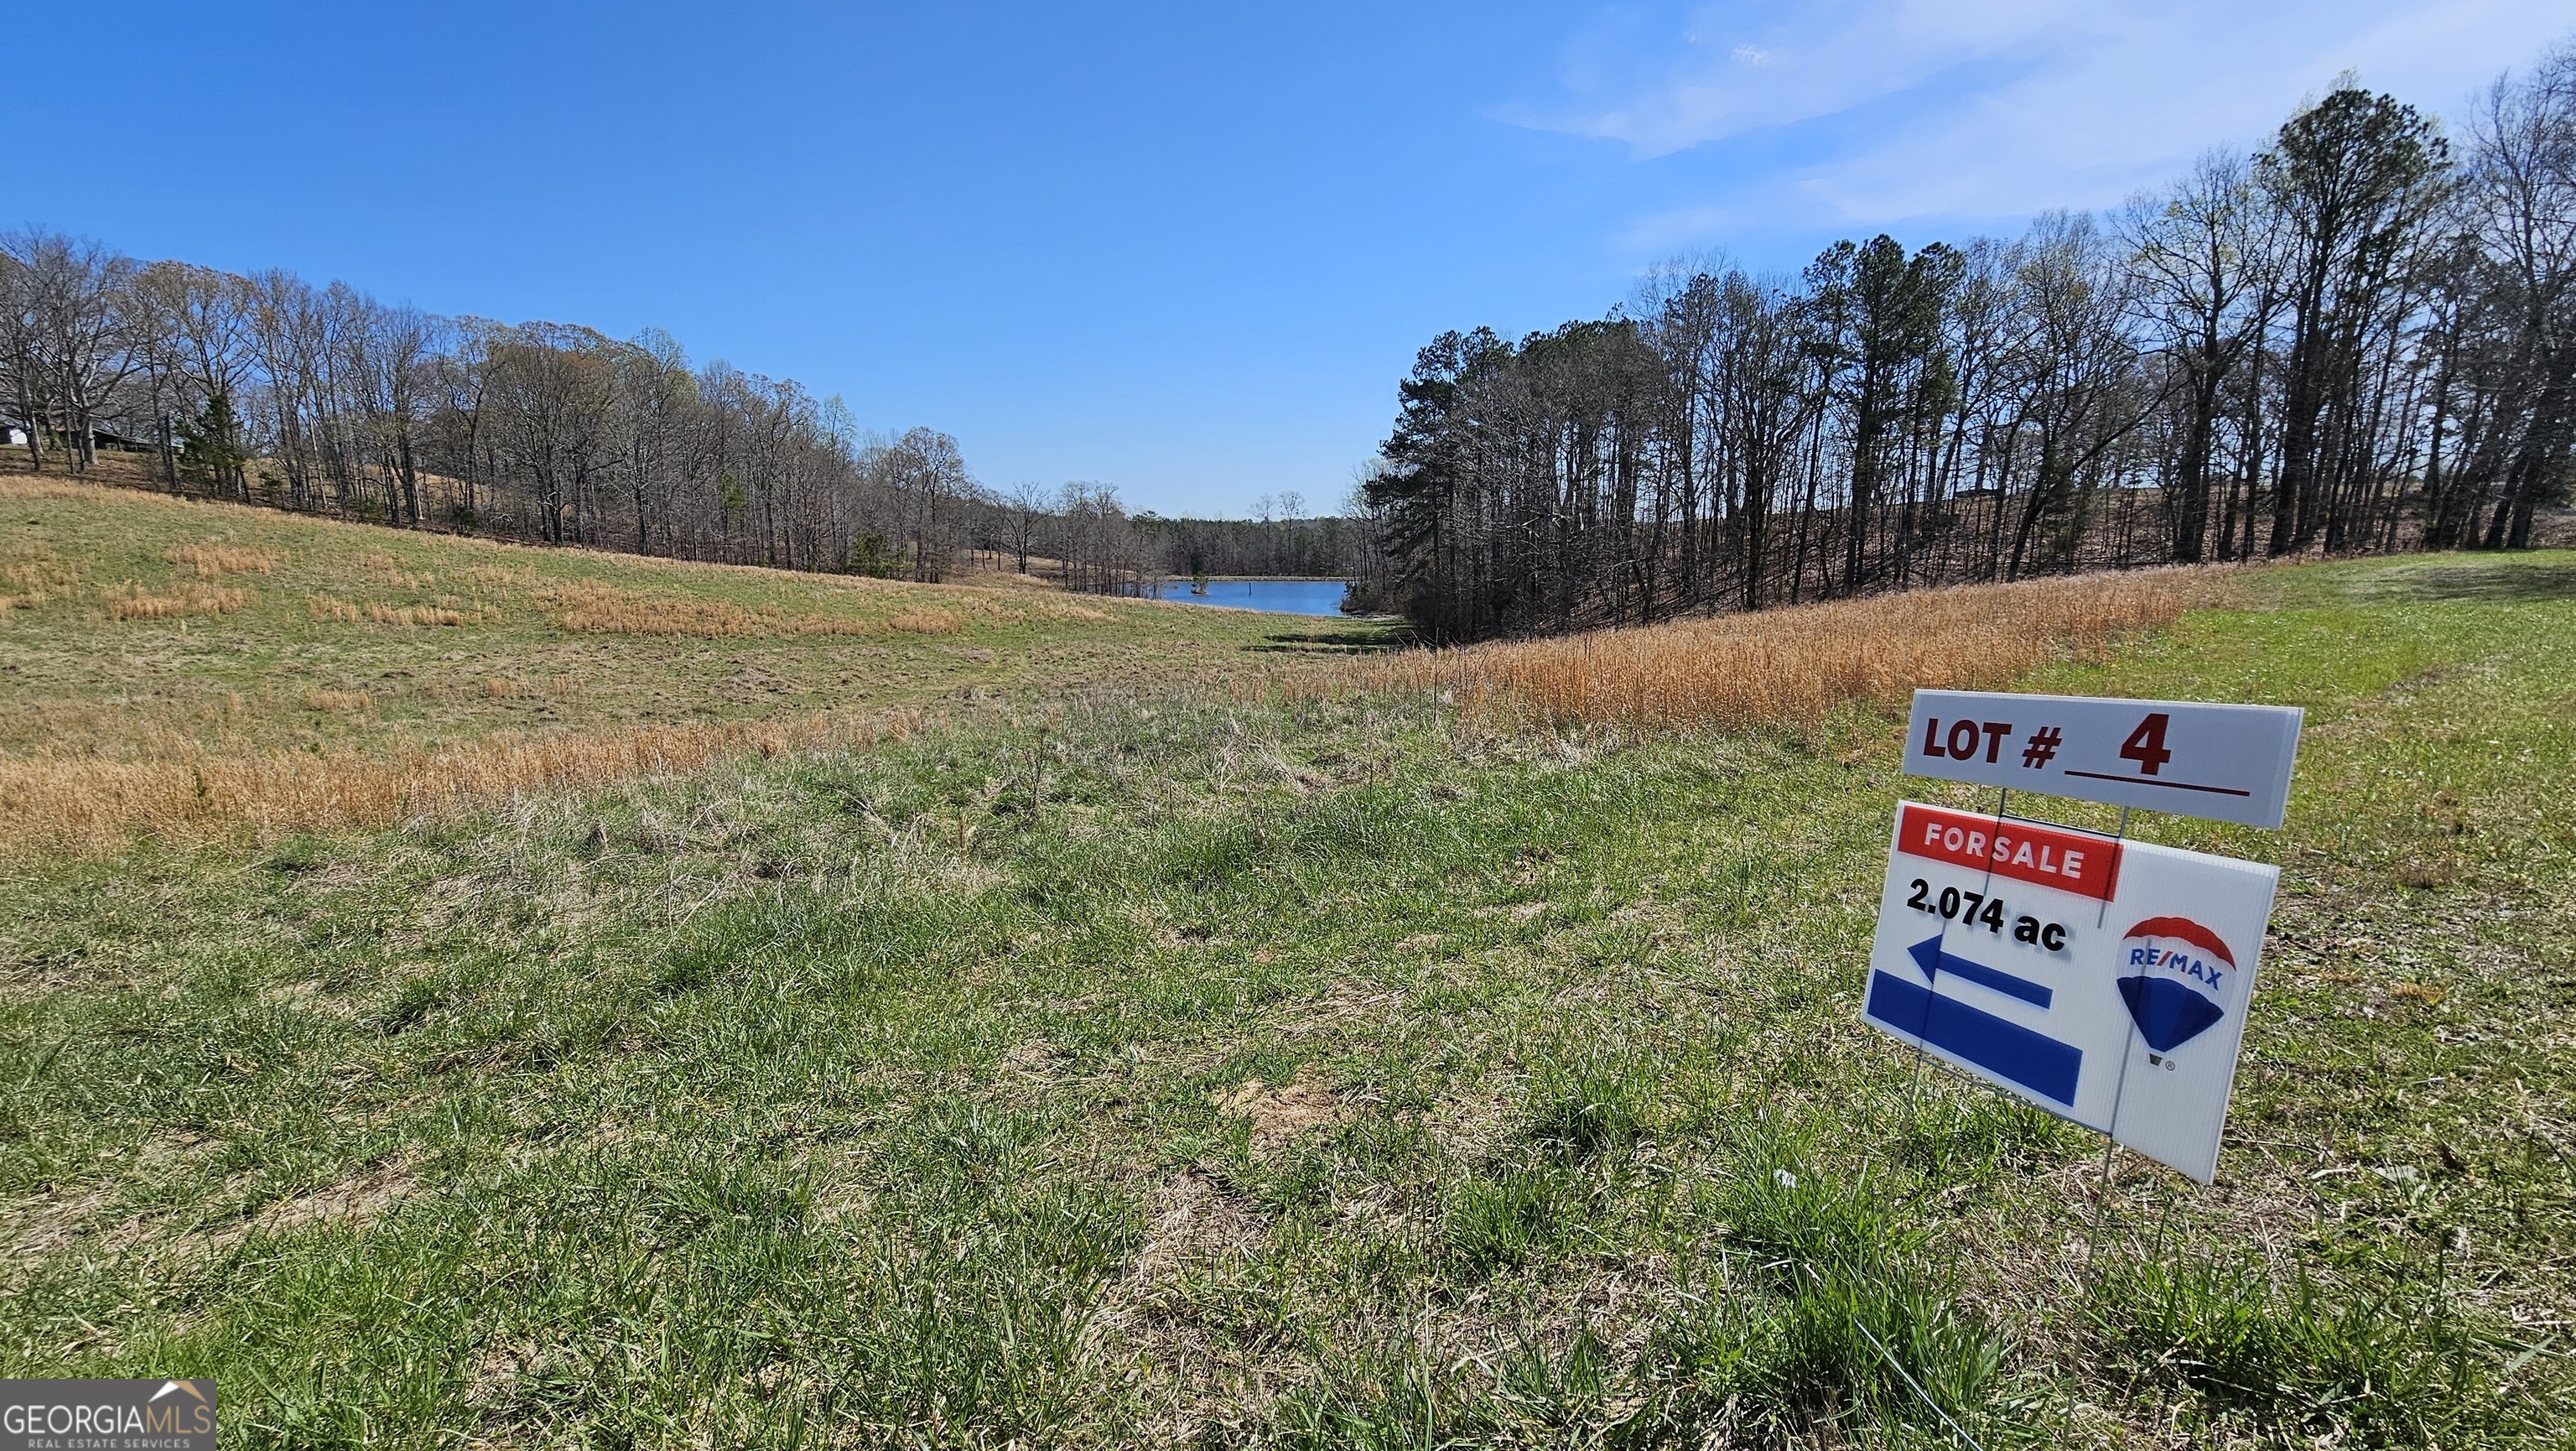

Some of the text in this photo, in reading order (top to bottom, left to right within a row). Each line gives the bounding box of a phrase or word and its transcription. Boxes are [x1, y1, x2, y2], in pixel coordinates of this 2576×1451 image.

[1924, 713, 2171, 775] LOT # 4
[1907, 878, 2067, 952] 2.074 ac
[2131, 949, 2223, 991] RE/MAX
